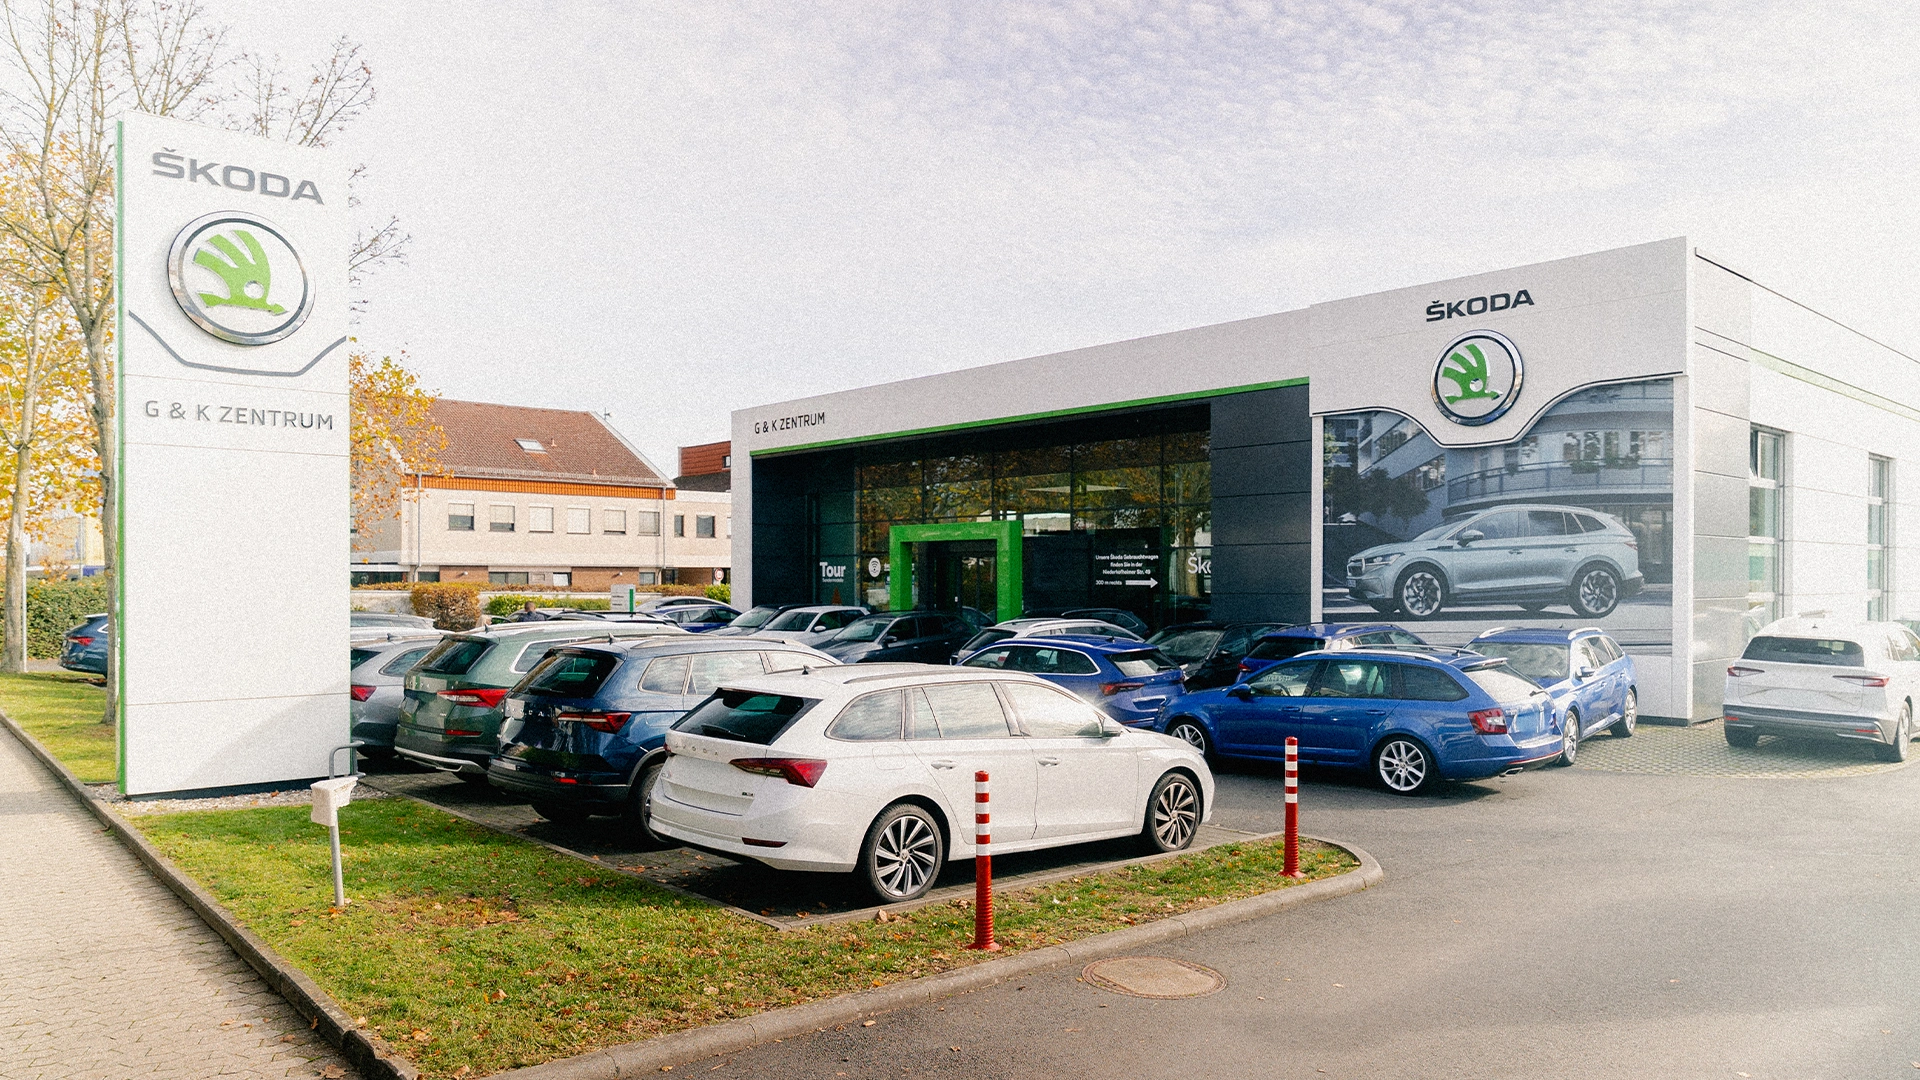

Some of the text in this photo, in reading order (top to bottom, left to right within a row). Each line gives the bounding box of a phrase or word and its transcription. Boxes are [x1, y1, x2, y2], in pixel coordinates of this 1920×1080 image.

[152, 147, 325, 205] ŠKODA
[1426, 289, 1535, 322] ŠKODA
[145, 400, 333, 430] G & K ZENTRUM
[754, 411, 825, 434] G & K ZENTRUM
[819, 561, 846, 578] Tour
